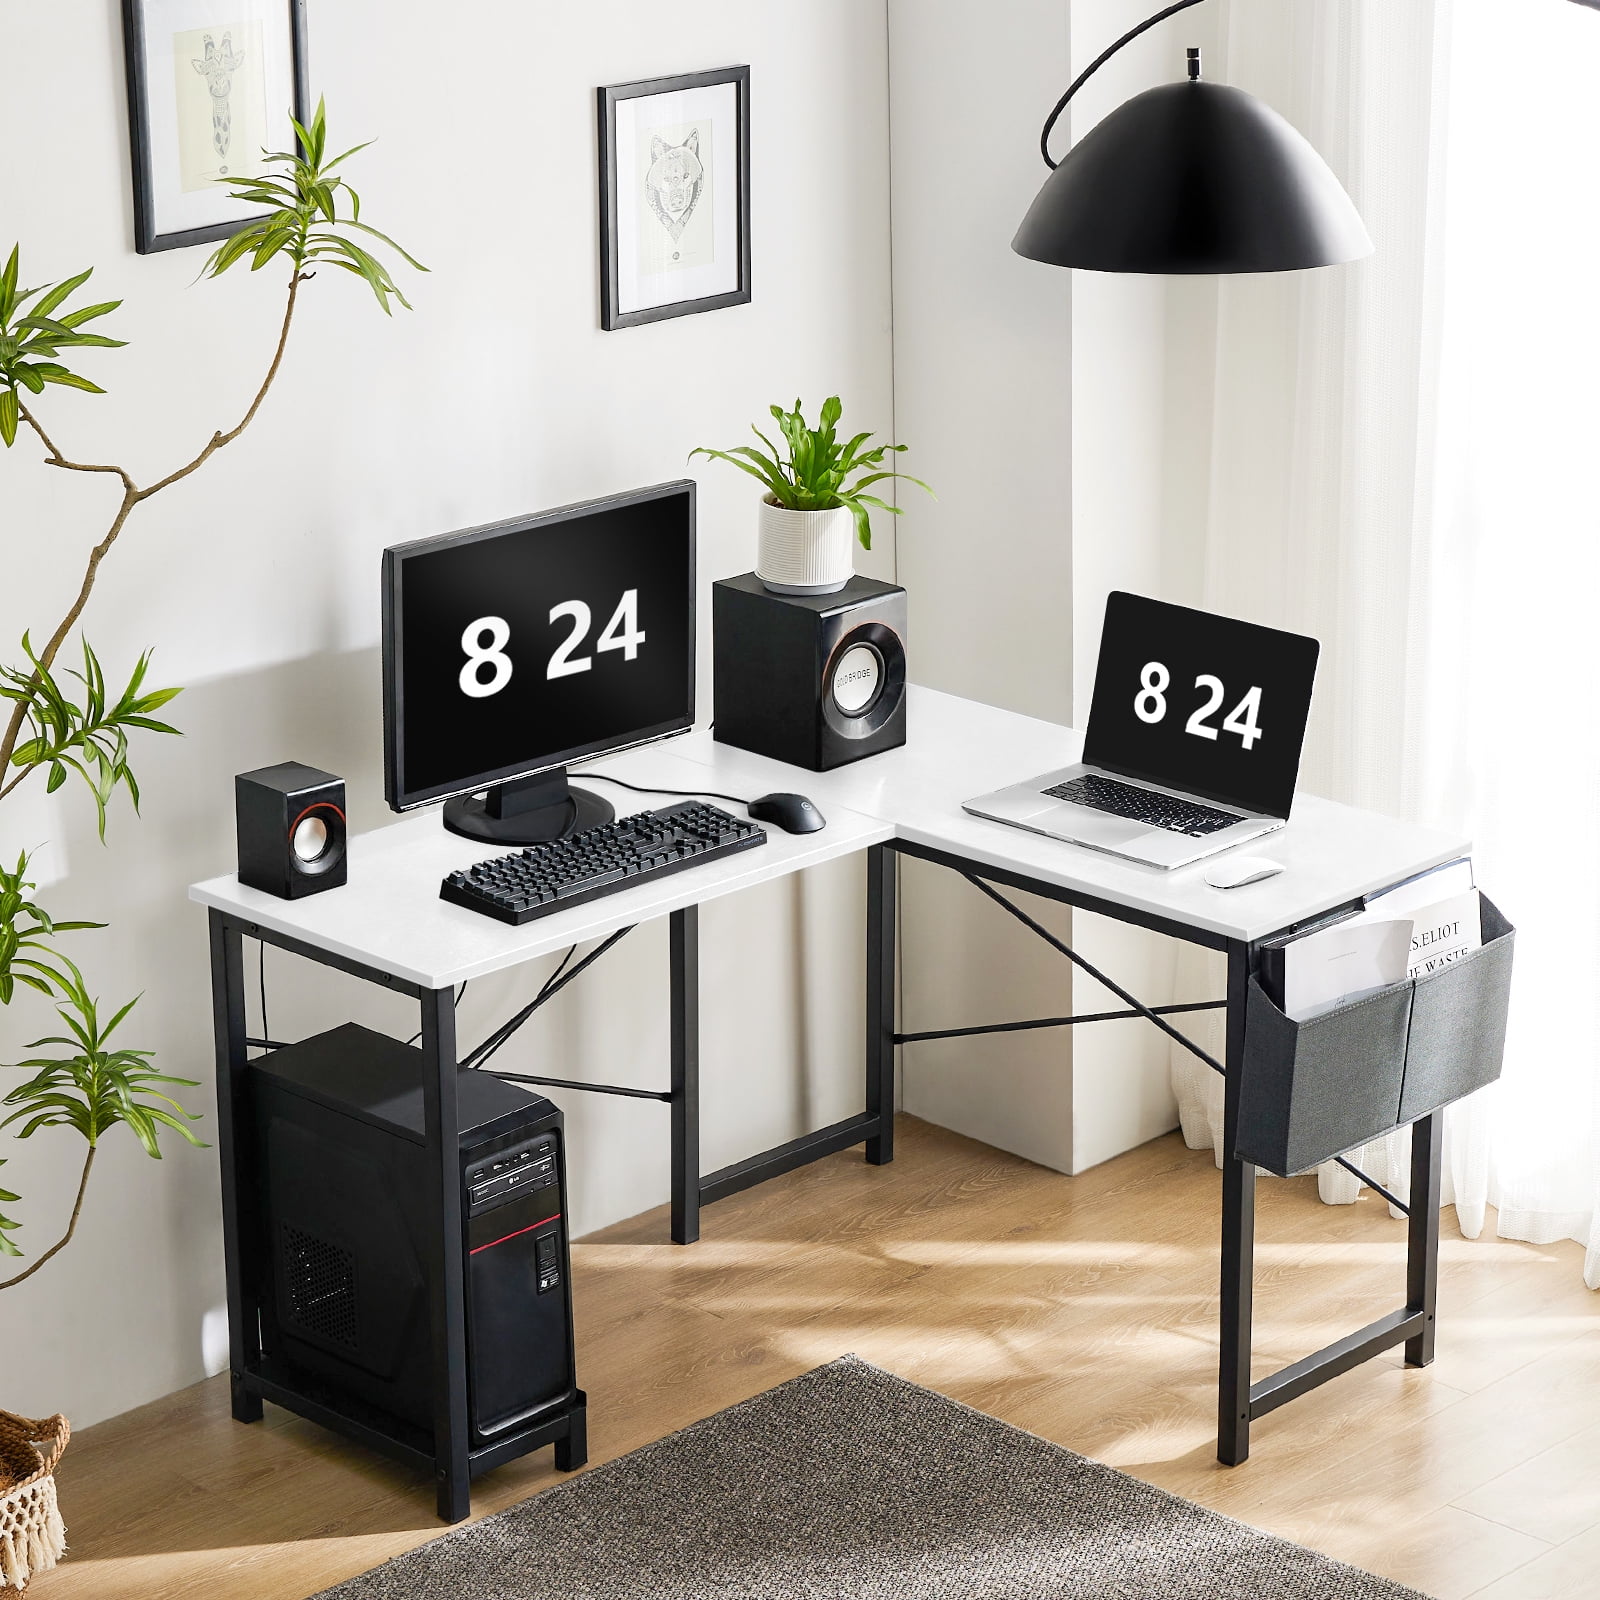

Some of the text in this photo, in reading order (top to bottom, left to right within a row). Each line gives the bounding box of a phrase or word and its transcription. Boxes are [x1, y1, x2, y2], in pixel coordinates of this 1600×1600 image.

[459, 588, 646, 698] 8 24
[1134, 661, 1263, 750] 8 24
